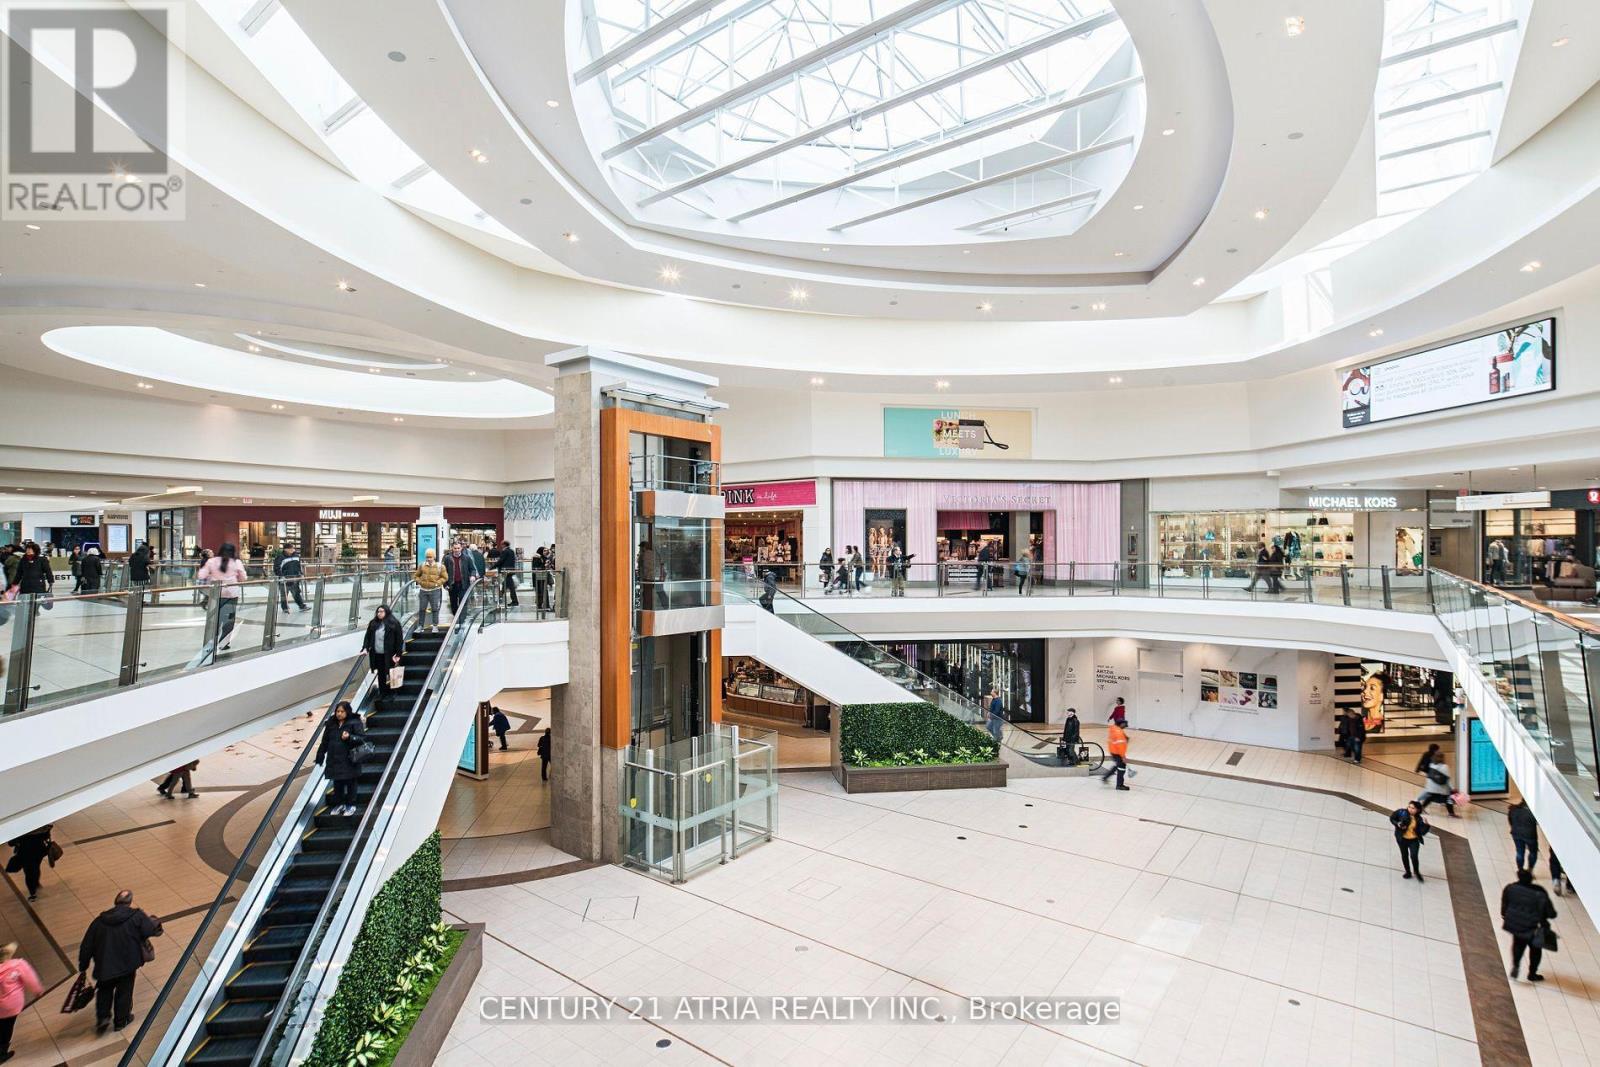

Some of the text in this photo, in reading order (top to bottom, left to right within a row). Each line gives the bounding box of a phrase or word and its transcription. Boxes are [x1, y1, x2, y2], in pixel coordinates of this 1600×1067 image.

[941, 410, 976, 419] LUNCH
[943, 429, 976, 439] MEETS
[939, 447, 977, 456] LUXURY
[1011, 495, 1052, 504] SECRET
[1308, 496, 1397, 508] MICHAEL KORS
[319, 509, 341, 520] MUJI
